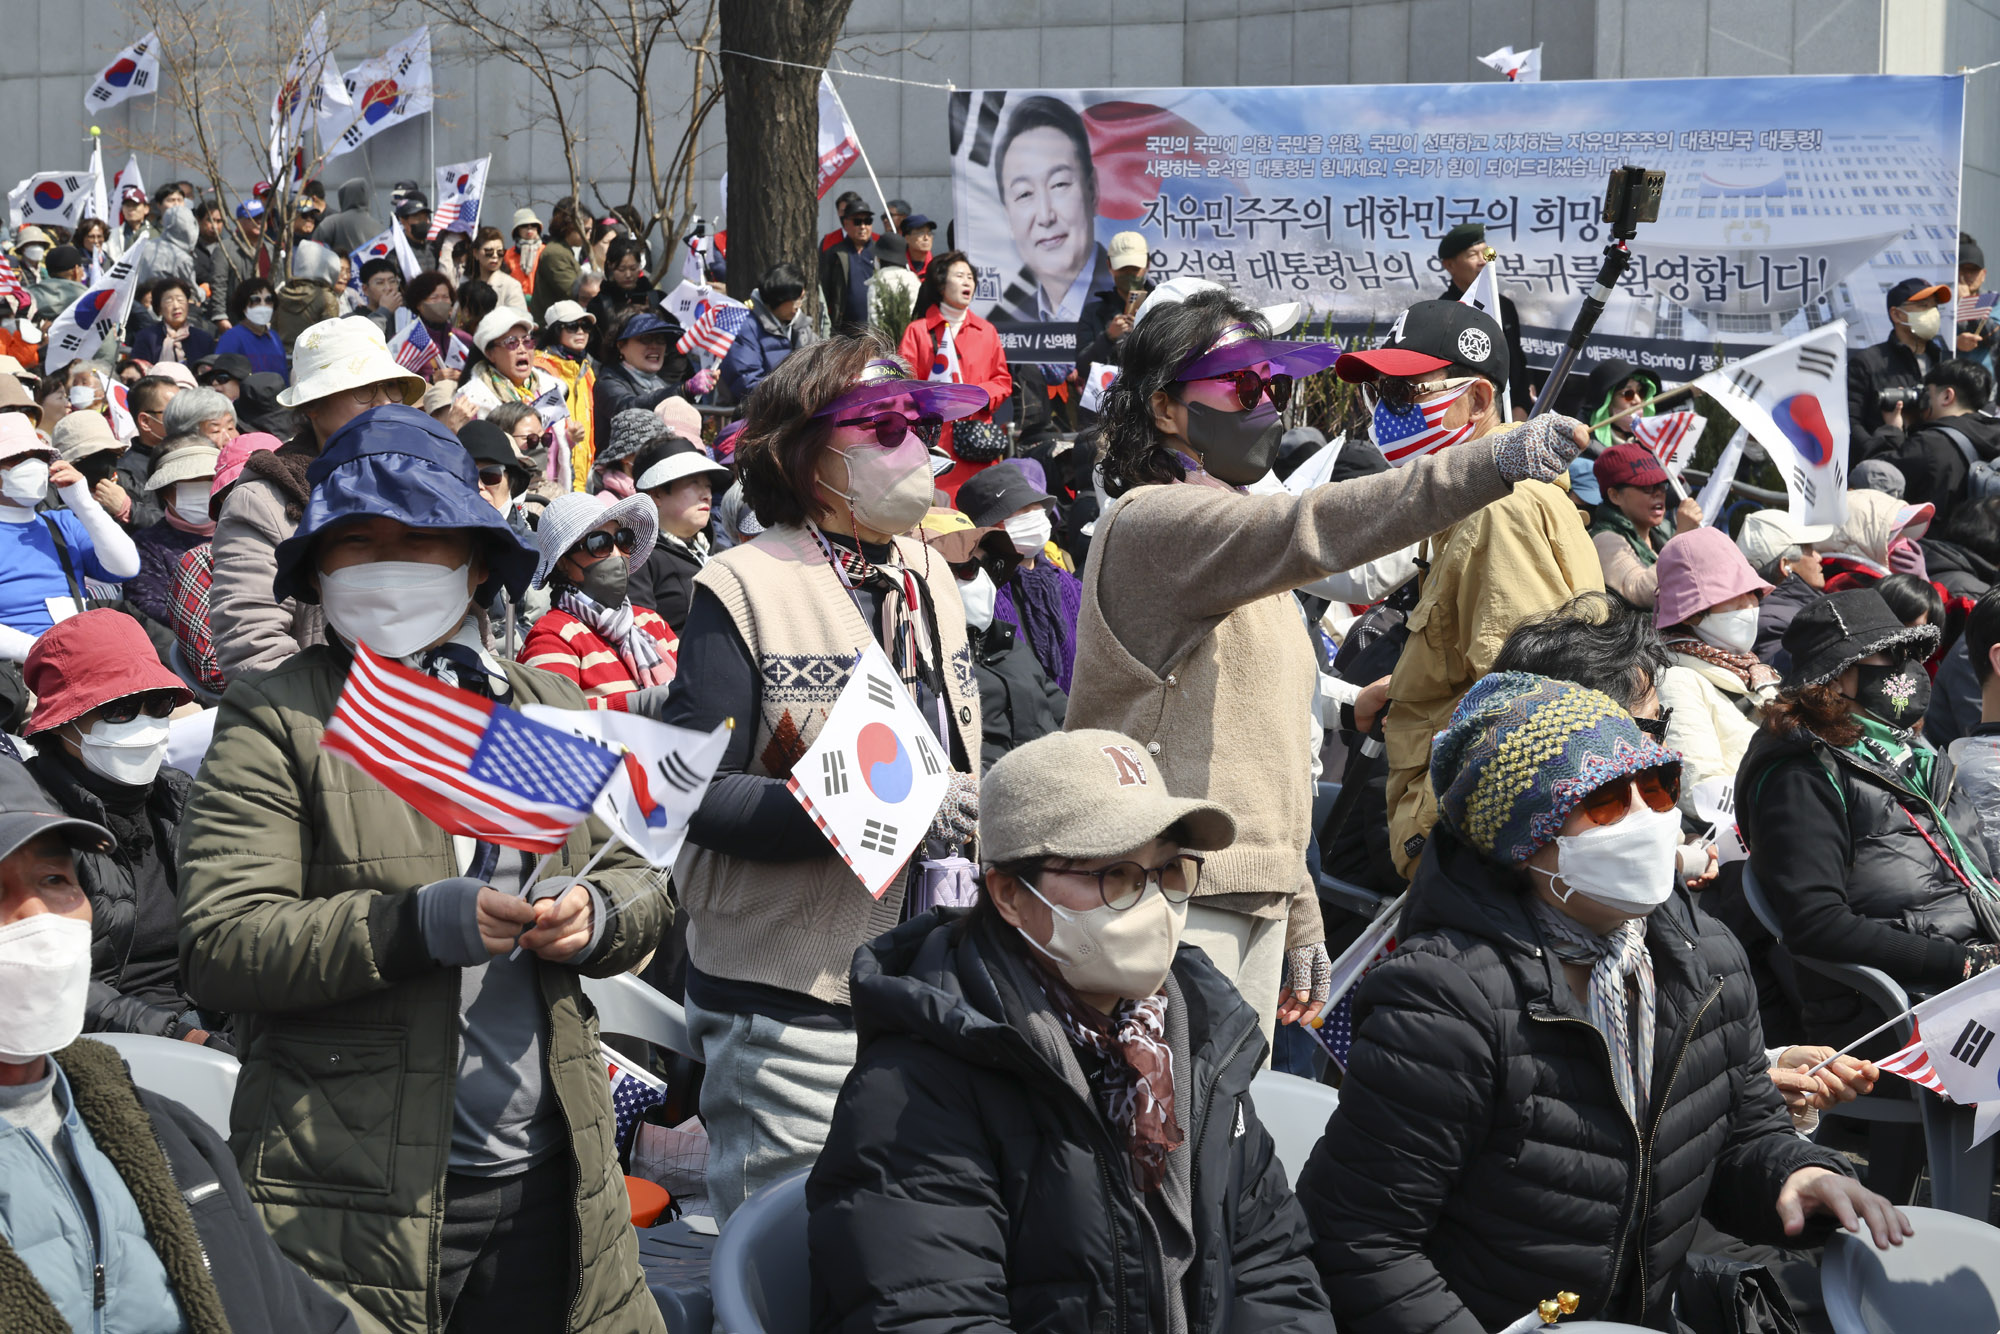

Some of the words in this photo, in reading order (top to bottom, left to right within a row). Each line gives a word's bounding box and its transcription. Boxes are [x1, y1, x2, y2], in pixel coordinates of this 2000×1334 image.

[1145, 135, 1189, 154] 국민의
[1193, 135, 1238, 154] 국민에
[1242, 135, 1273, 154] 의한
[1276, 135, 1323, 154] 국민을
[1328, 134, 1364, 154] 위한,
[1369, 133, 1418, 153] 국민이
[1423, 133, 1489, 153] 선택하고
[1494, 132, 1562, 152] 지지하는
[1567, 131, 1674, 152] 자유민주주의
[1680, 130, 1753, 151] 대한민국
[1759, 129, 1823, 151] 대통령!
[1144, 159, 1202, 179] 사랑하는
[1206, 159, 1250, 178] 윤석열
[1255, 159, 1316, 178] 대통령님
[1321, 158, 1388, 178] 힘내세요!
[1392, 158, 1442, 178] 우리가
[1447, 158, 1481, 177] 힘이
[1141, 195, 1332, 241] 자유민주주의
[1343, 195, 1518, 242] 대한민국의
[1530, 195, 1615, 243] 희망
[1246, 250, 1419, 291] 대통령님의
[1616, 254, 1828, 305] 환영합니다!
[1640, 351, 1686, 371] Spring
